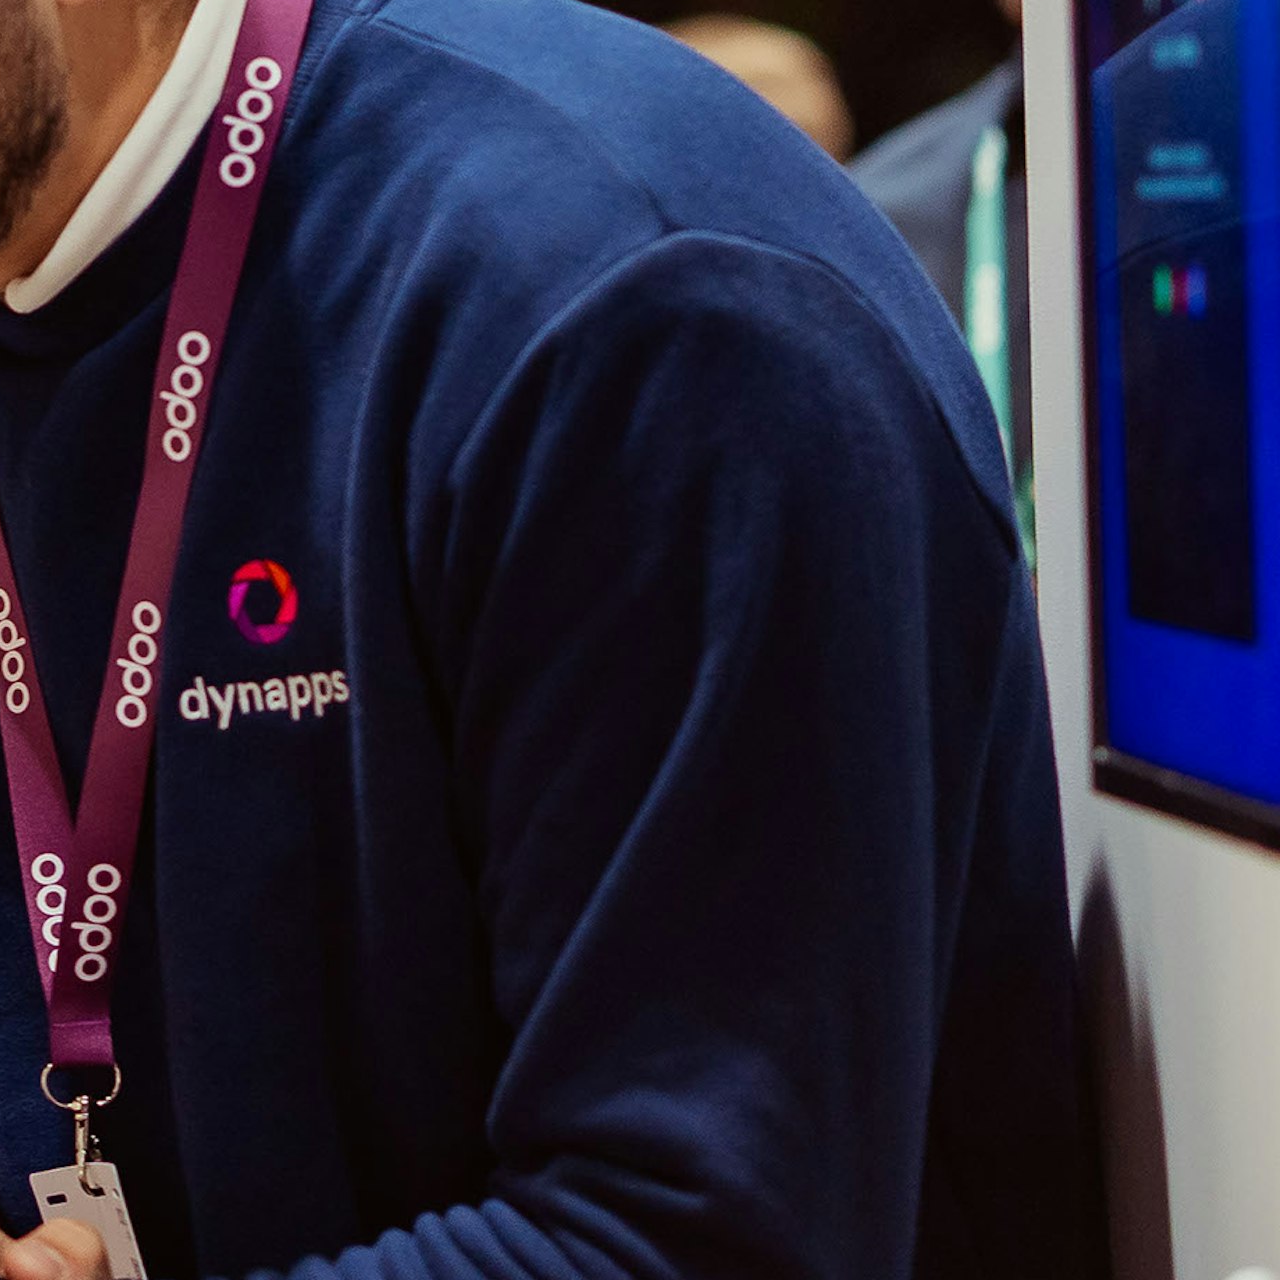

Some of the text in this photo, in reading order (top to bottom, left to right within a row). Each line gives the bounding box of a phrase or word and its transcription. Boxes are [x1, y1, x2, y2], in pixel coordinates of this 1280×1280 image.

[220, 56, 282, 187] odoo
[160, 331, 211, 461] odoo
[115, 600, 161, 728] odoo
[179, 670, 350, 731] dynapps
[31, 852, 67, 972] odo
[71, 863, 122, 982] odoo
